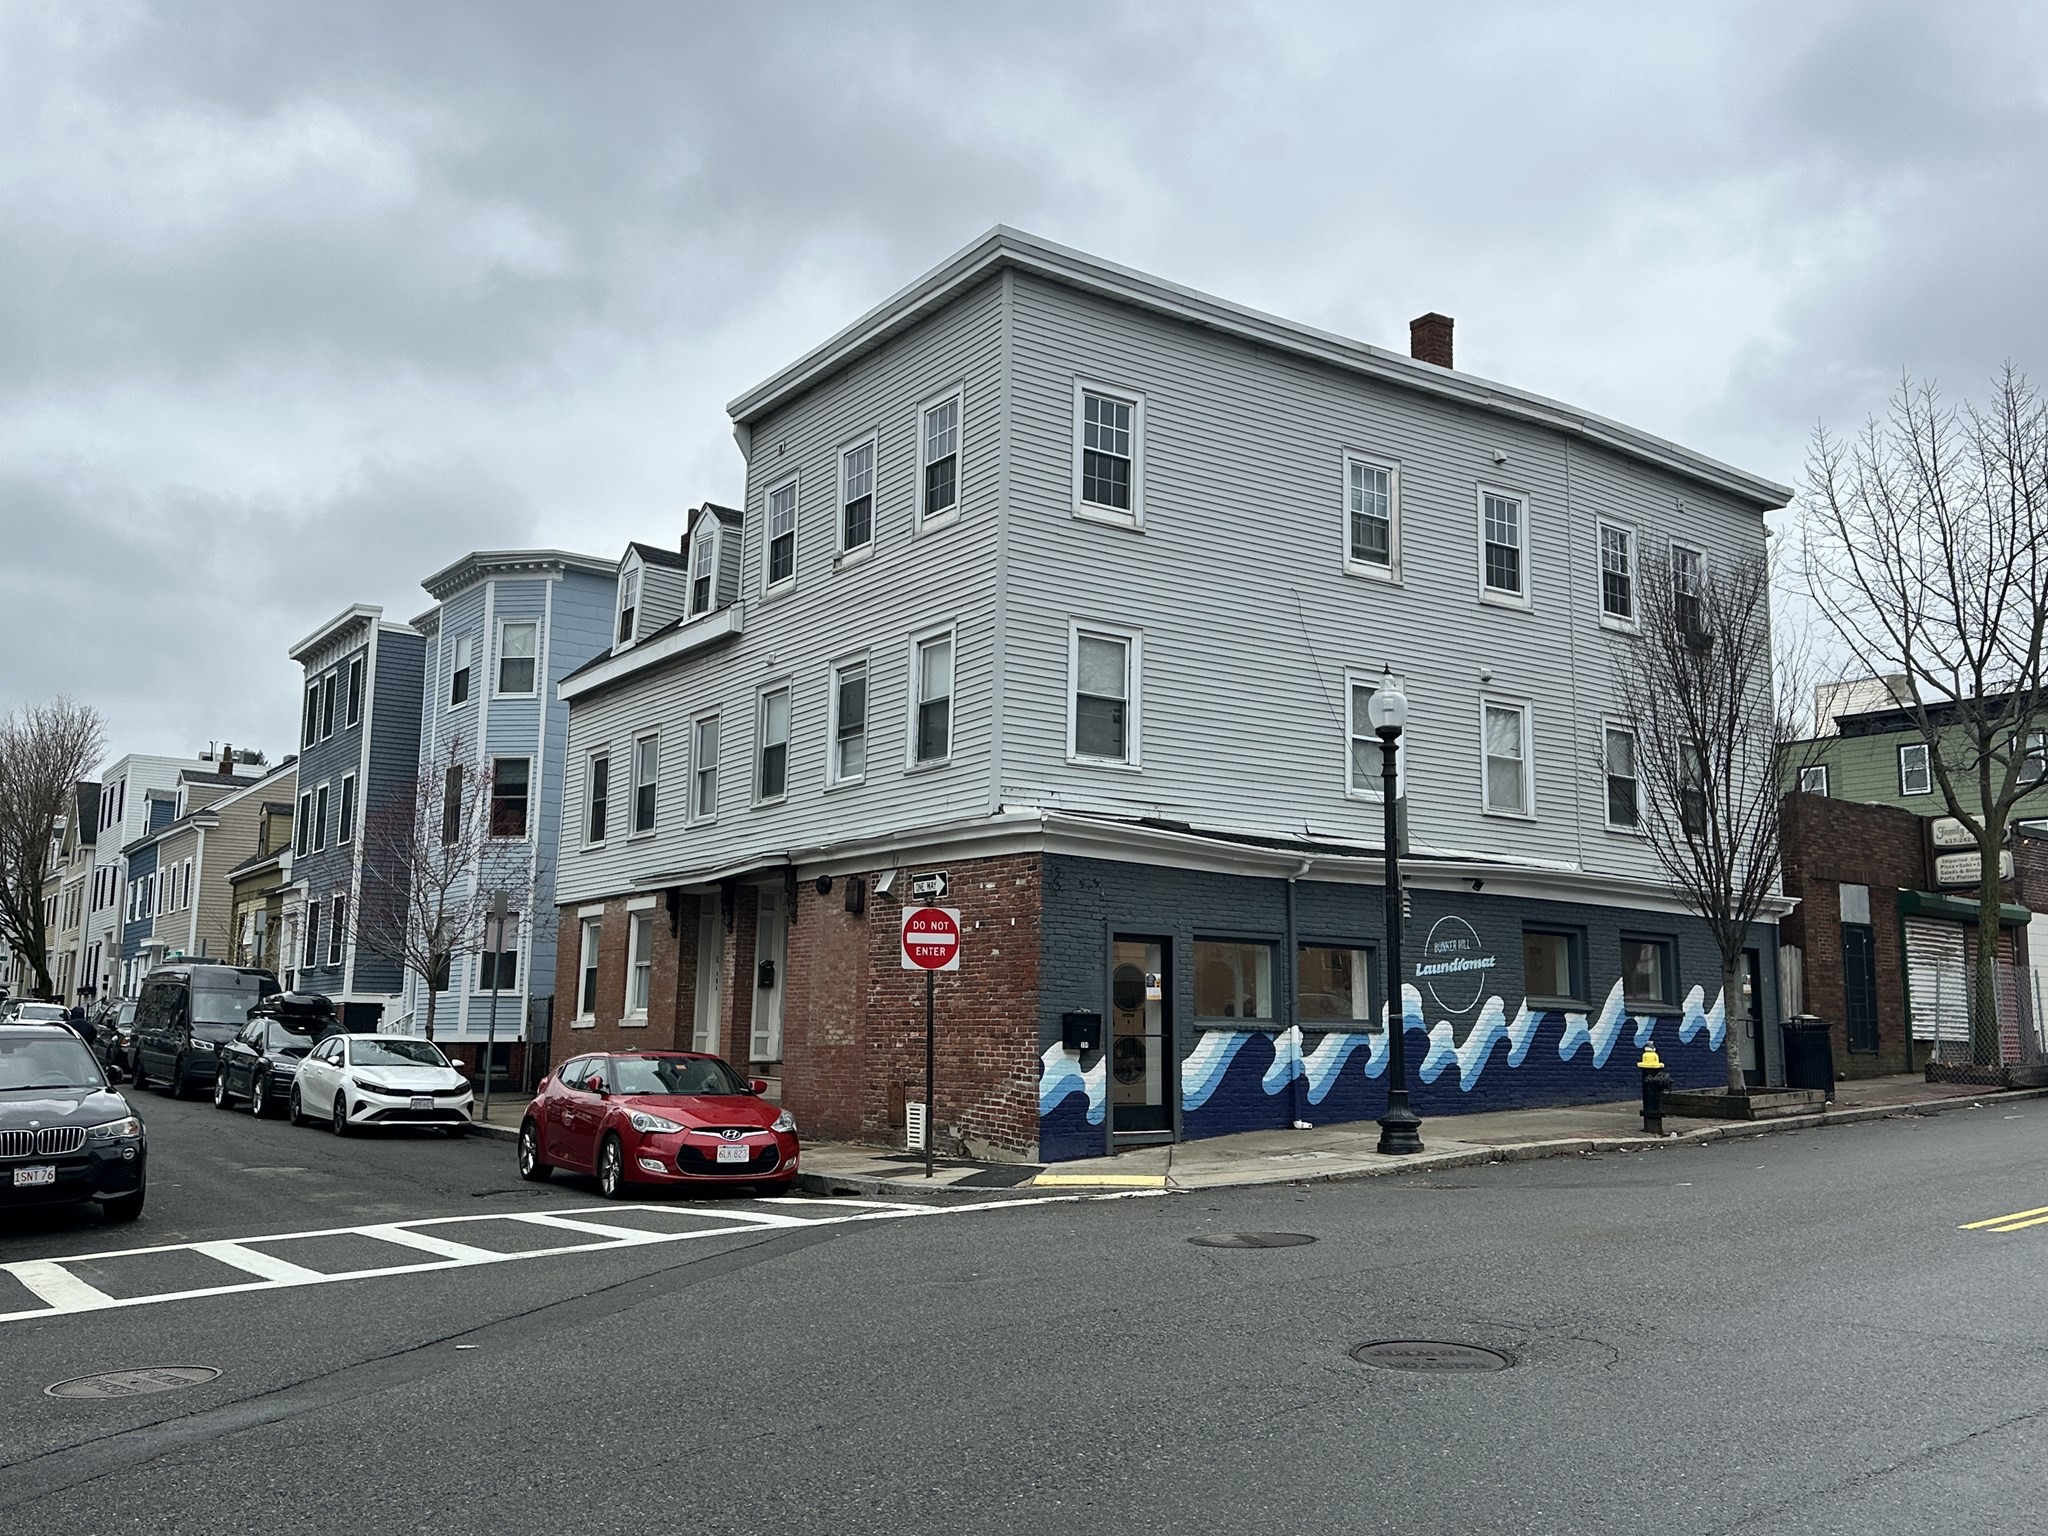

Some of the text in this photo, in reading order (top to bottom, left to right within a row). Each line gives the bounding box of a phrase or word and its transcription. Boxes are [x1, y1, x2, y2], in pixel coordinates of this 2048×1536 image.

[1936, 825, 1965, 840] Family
[915, 880, 936, 892] ONE WAY
[913, 920, 949, 931] DO NOT
[915, 946, 946, 956] ENTER
[1434, 939, 1471, 953] BUNKER HILL
[1415, 955, 1497, 976] Laundromat
[733, 1149, 747, 1158] 823
[15, 1169, 54, 1182] 1SNT 76
